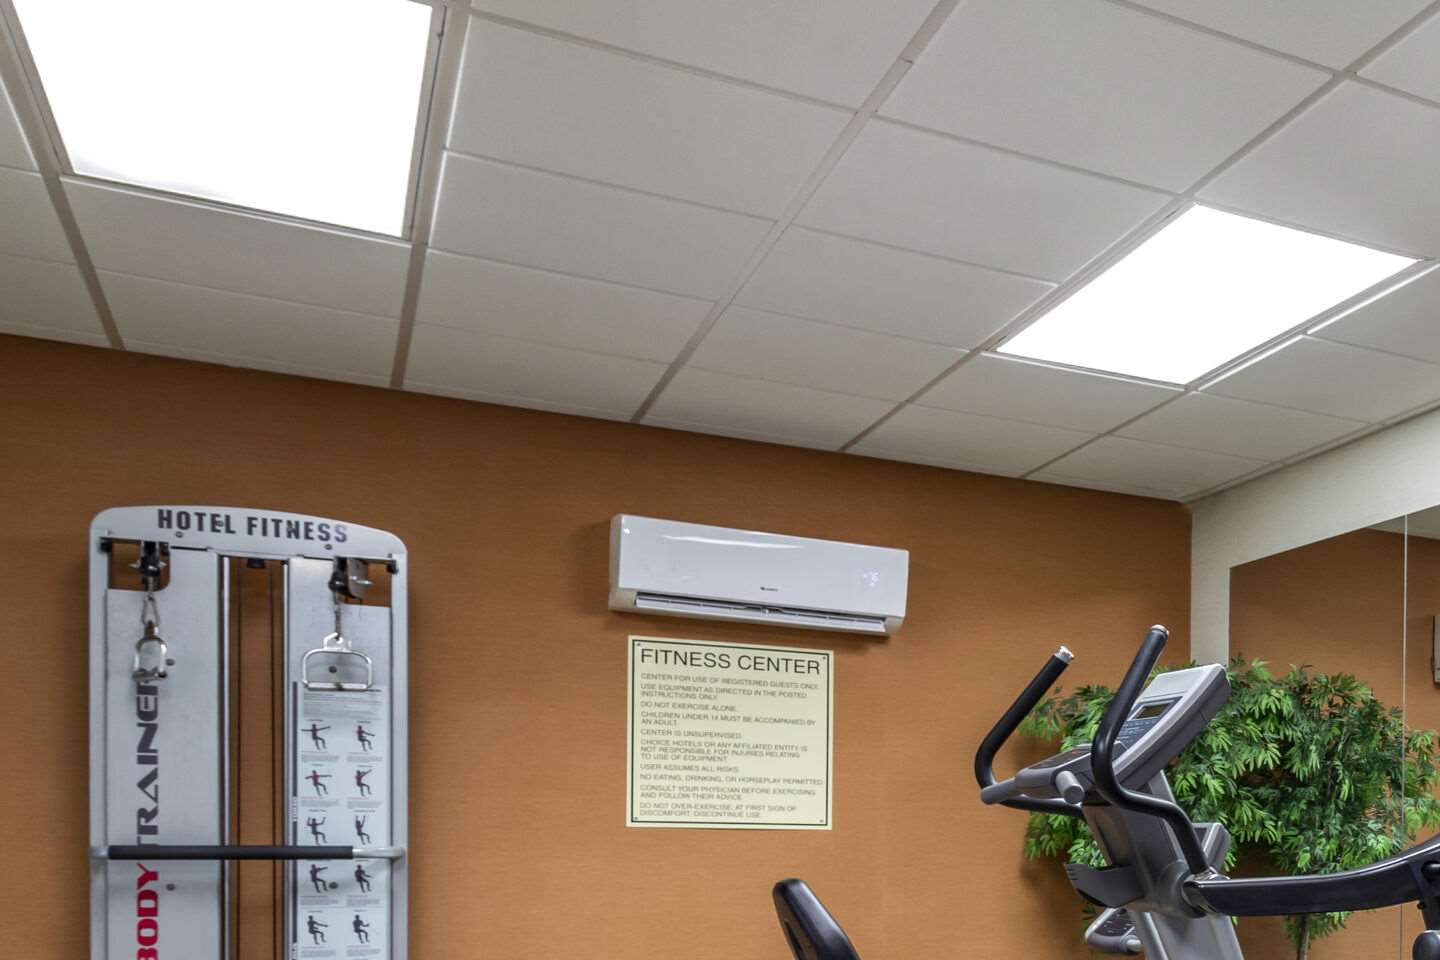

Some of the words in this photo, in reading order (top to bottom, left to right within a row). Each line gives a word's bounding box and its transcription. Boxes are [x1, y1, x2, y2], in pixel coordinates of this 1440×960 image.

[158, 509, 236, 534] HOTEL
[247, 516, 347, 542] FITNESS
[641, 649, 731, 669] FITNESS
[737, 655, 821, 675] CENTER
[641, 673, 672, 681] CENTER
[722, 678, 768, 687] REGISTERED
[641, 691, 697, 699] INSTRUCTIONS
[659, 685, 702, 693] EQUIPMENT
[763, 689, 776, 697] THE
[778, 690, 807, 698] POSTED
[672, 702, 709, 710] EXERCISE
[641, 711, 681, 719] CHILDREN
[754, 717, 805, 725] ACCOMPANIED
[659, 747, 711, 755] RESPONSIBLE
[773, 788, 816, 796] EXERCISING
